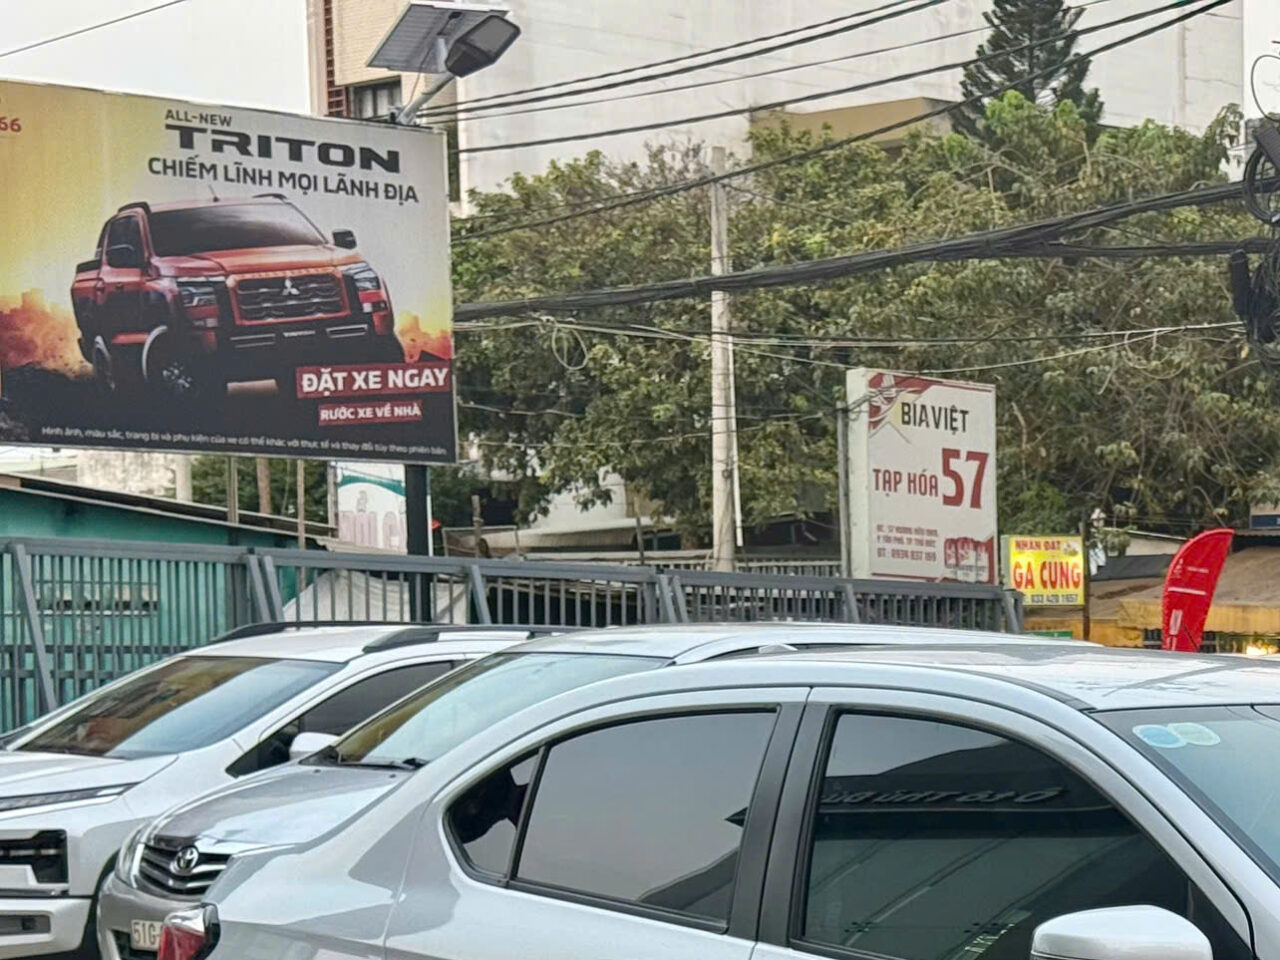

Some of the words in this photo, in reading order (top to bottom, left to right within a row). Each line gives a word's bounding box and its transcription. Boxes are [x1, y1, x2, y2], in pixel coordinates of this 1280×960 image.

[164, 109, 233, 128] ALL-NEW
[164, 123, 401, 174] TRITON
[148, 154, 218, 181] CHIẾM
[223, 161, 273, 188] LĨNH
[278, 172, 318, 196] MỌI
[323, 173, 379, 199] LÃNH
[384, 183, 419, 206] ĐỊA
[301, 368, 348, 397] ĐẶT
[352, 370, 382, 390] XE
[387, 368, 449, 388] NGAY
[357, 407, 374, 419] XE
[393, 402, 421, 417] NHÀ
[901, 402, 930, 429] BIA
[930, 403, 970, 436] VIỆT
[872, 468, 903, 499] TẠP
[907, 468, 939, 498] HÓA
[942, 447, 990, 510] 57
